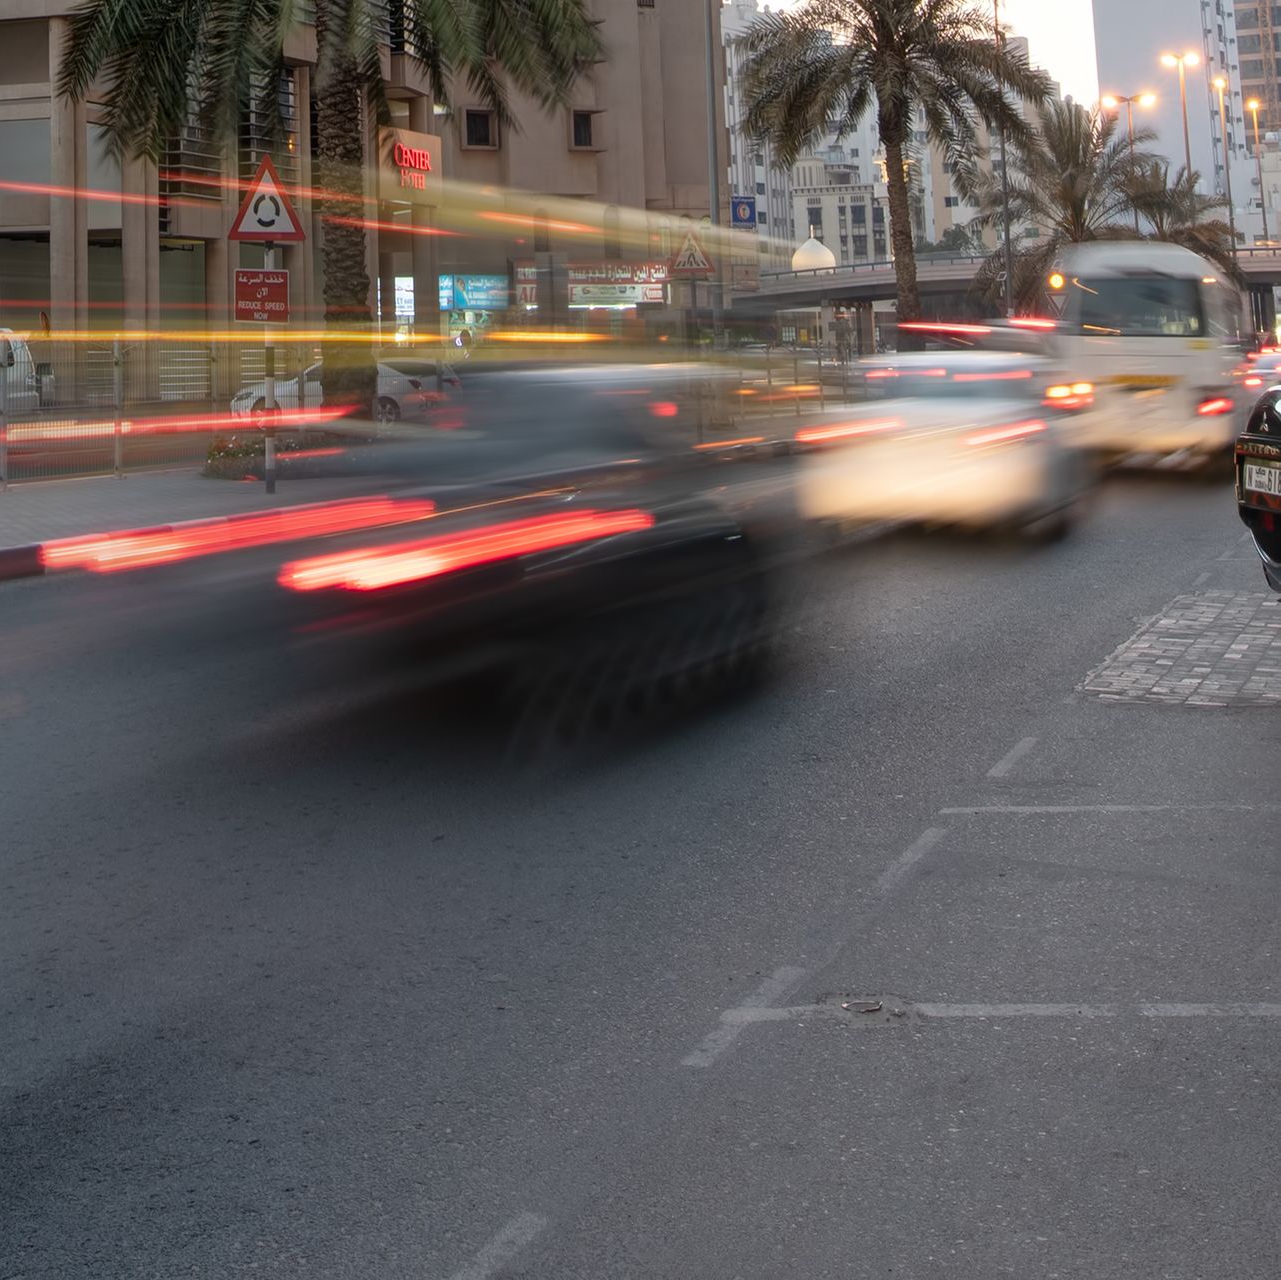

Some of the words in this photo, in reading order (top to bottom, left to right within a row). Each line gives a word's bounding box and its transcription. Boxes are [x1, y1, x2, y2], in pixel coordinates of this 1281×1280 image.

[394, 142, 432, 171] CENTER
[238, 300, 262, 310] REDUCE
[264, 302, 285, 311] SPEED
[253, 311, 269, 321] NOW
